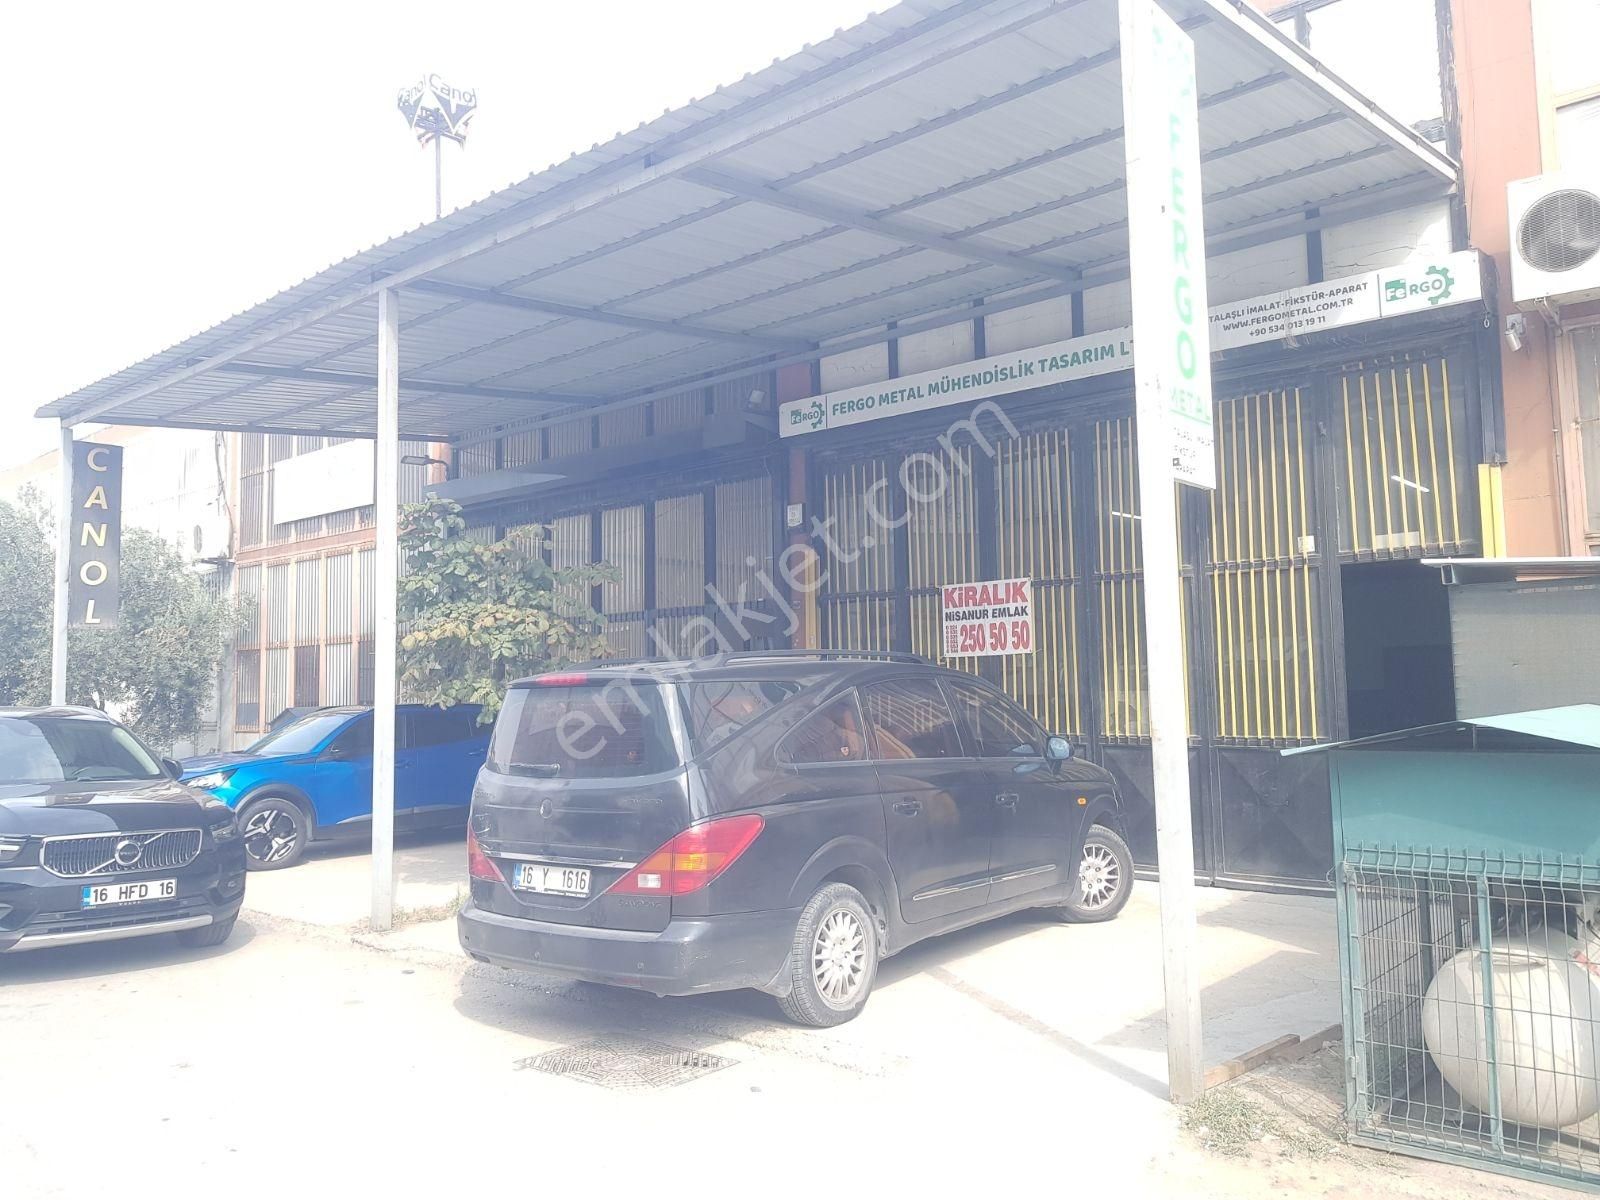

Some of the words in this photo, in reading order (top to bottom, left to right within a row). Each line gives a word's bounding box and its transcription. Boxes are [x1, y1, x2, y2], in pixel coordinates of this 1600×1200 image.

[1208, 309, 1244, 323] TALAŞLI
[1223, 297, 1353, 331] WWW.FERGOMETAL.COM.TR
[1249, 327, 1266, 337] +90
[1268, 323, 1285, 334] 534
[1305, 317, 1315, 326] 19
[1317, 315, 1326, 324] 11
[832, 396, 875, 416] FERGO
[879, 386, 925, 407] METAL
[928, 359, 1034, 396] MÜHENDİSLİK
[1038, 343, 1115, 373] TASARIM
[79, 447, 110, 624] CANOL
[991, 605, 1028, 619] EMLAK
[960, 623, 985, 653] 250
[989, 621, 1008, 652] 50
[1011, 620, 1030, 651] 50
[522, 866, 533, 884] 16
[543, 867, 550, 886] Y
[562, 869, 587, 890] 1616
[93, 888, 108, 903] 16
[118, 884, 149, 900] HFD
[160, 881, 174, 896] 16
